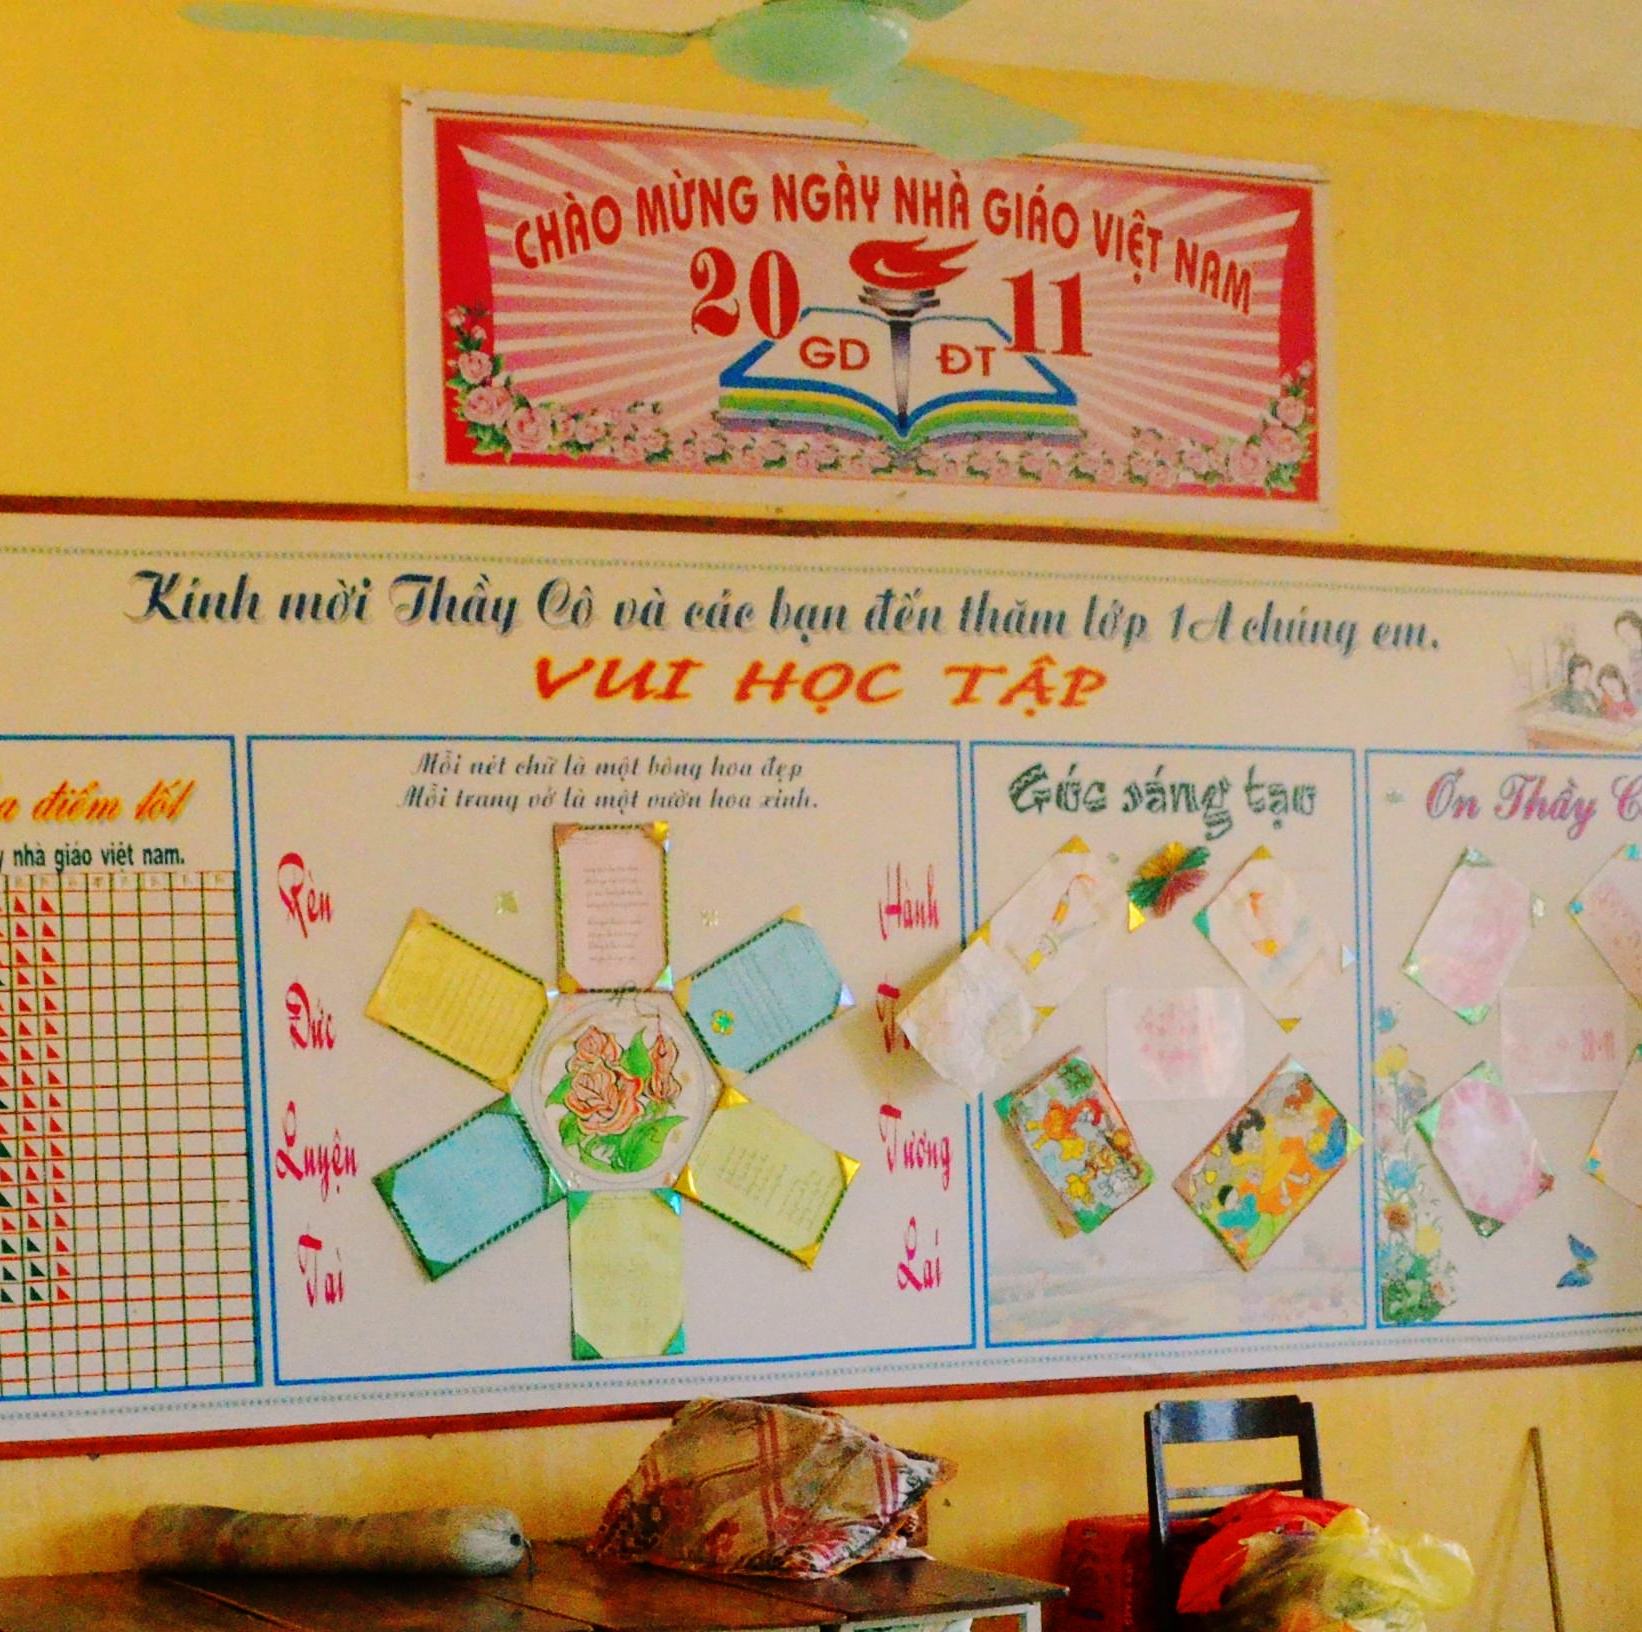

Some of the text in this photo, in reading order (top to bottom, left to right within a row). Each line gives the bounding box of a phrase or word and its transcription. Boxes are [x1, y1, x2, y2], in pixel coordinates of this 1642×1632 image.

[514, 160, 1252, 315] CHÀO MỪNG NGÀY NHÀ GIÁO VIỆT NAM
[688, 246, 1093, 358] 20 11
[798, 335, 997, 377] GD ĐT
[123, 569, 1442, 659] Kính mời Thầy Cô và các bạn đến thăm lớp 1A chúng em.
[534, 652, 1108, 718] VUI HỌC TẬP
[31, 779, 124, 823] điểm
[133, 778, 197, 822] tốt
[397, 782, 820, 814] Mỗi trang vở là một vườn hoa xinh.
[410, 748, 804, 784] Mỗi nét chữ là một bông hoa đẹp
[1009, 762, 1317, 842] Góc sáng tạo
[1425, 766, 1481, 820] Ơn
[1493, 774, 1597, 842] Thầy
[13, 840, 46, 868] nhà
[54, 840, 93, 873] giáo
[100, 841, 134, 871] việt
[142, 846, 186, 866] nam.
[878, 861, 940, 942] Hành
[274, 851, 358, 1309] Rèn Đức Luyện Tài
[896, 1215, 941, 1293] Lai
